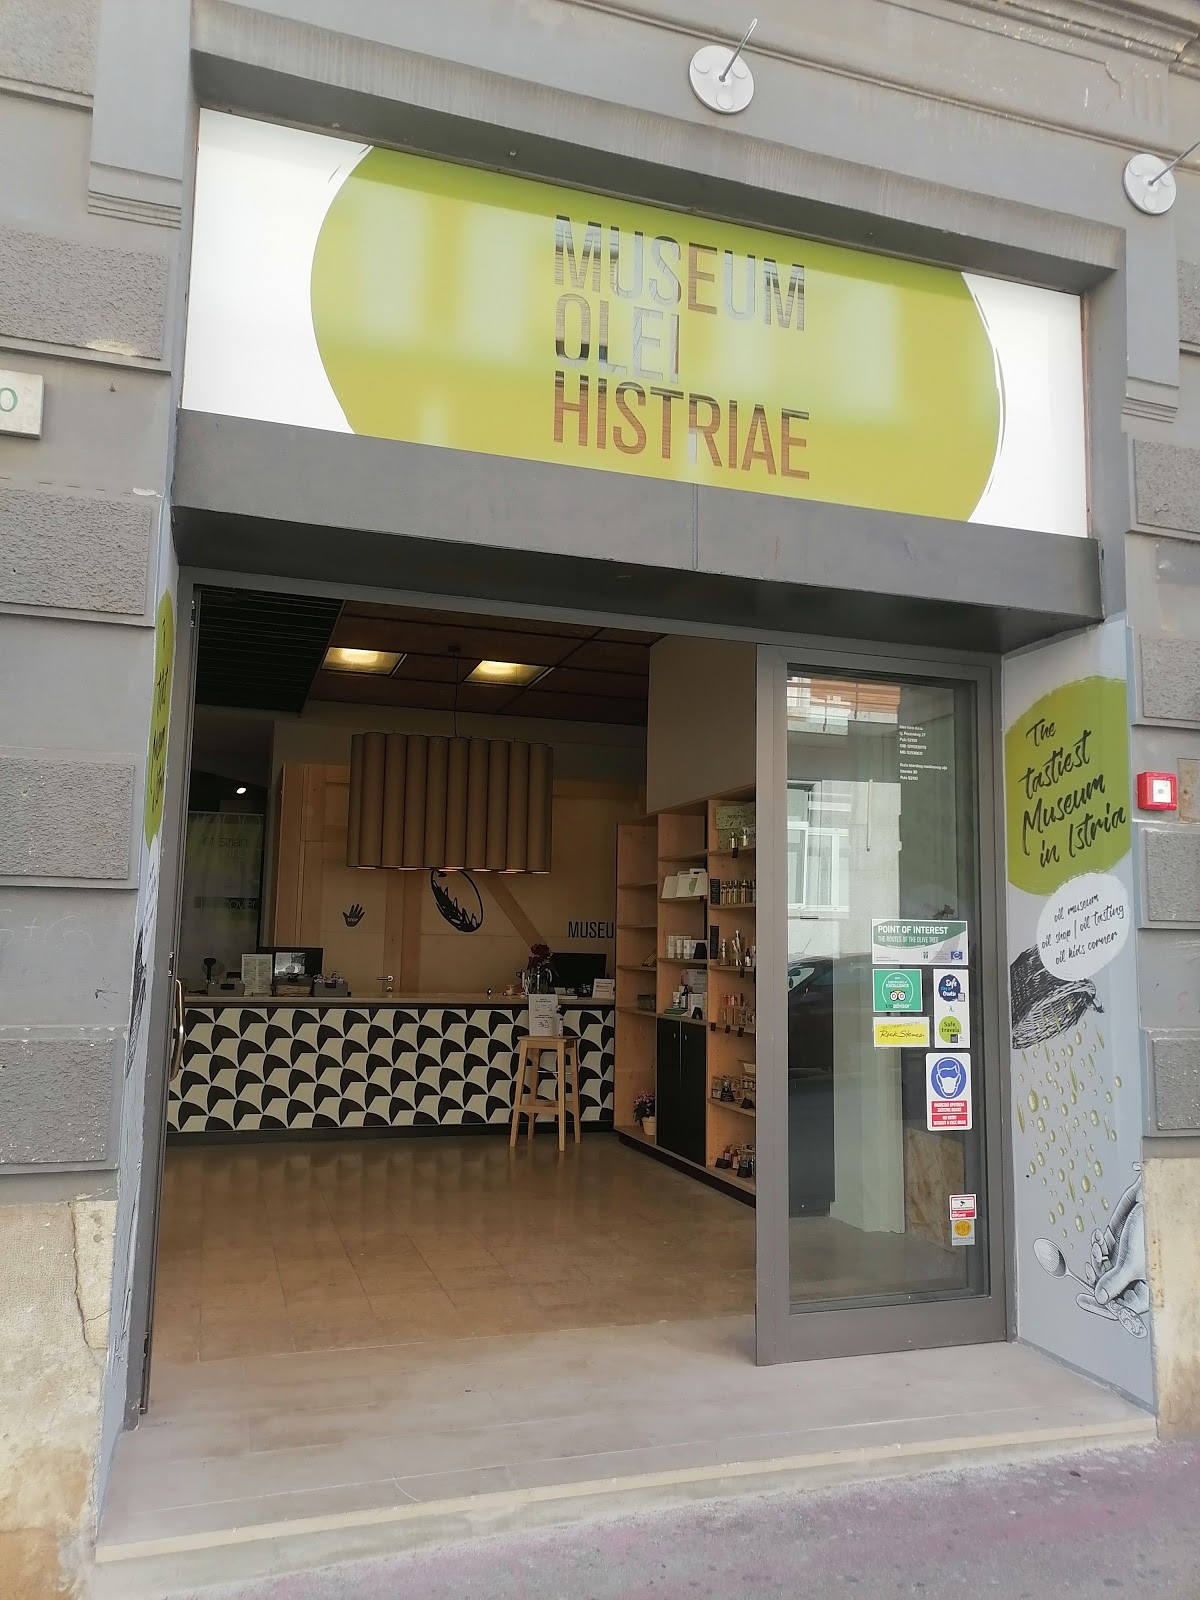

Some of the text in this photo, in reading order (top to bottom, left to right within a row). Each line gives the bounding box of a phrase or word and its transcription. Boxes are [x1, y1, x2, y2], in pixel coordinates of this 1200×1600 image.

[554, 214, 805, 331] MUSEUM
[555, 293, 680, 384] OLEI
[553, 370, 810, 480] HISTRIAE
[1025, 718, 1056, 747] The
[1018, 729, 1092, 800] tastiest
[1022, 773, 1106, 856] Museum
[1040, 802, 1127, 868] in Istria
[878, 925, 949, 935] POINT OF INTEREST
[1041, 904, 1125, 949] oil shop oil tasting
[1053, 893, 1099, 923] oil museum
[916, 936, 929, 944] OLIVE
[1055, 931, 1118, 965] oil kids corner
[945, 978, 958, 989] Safe
